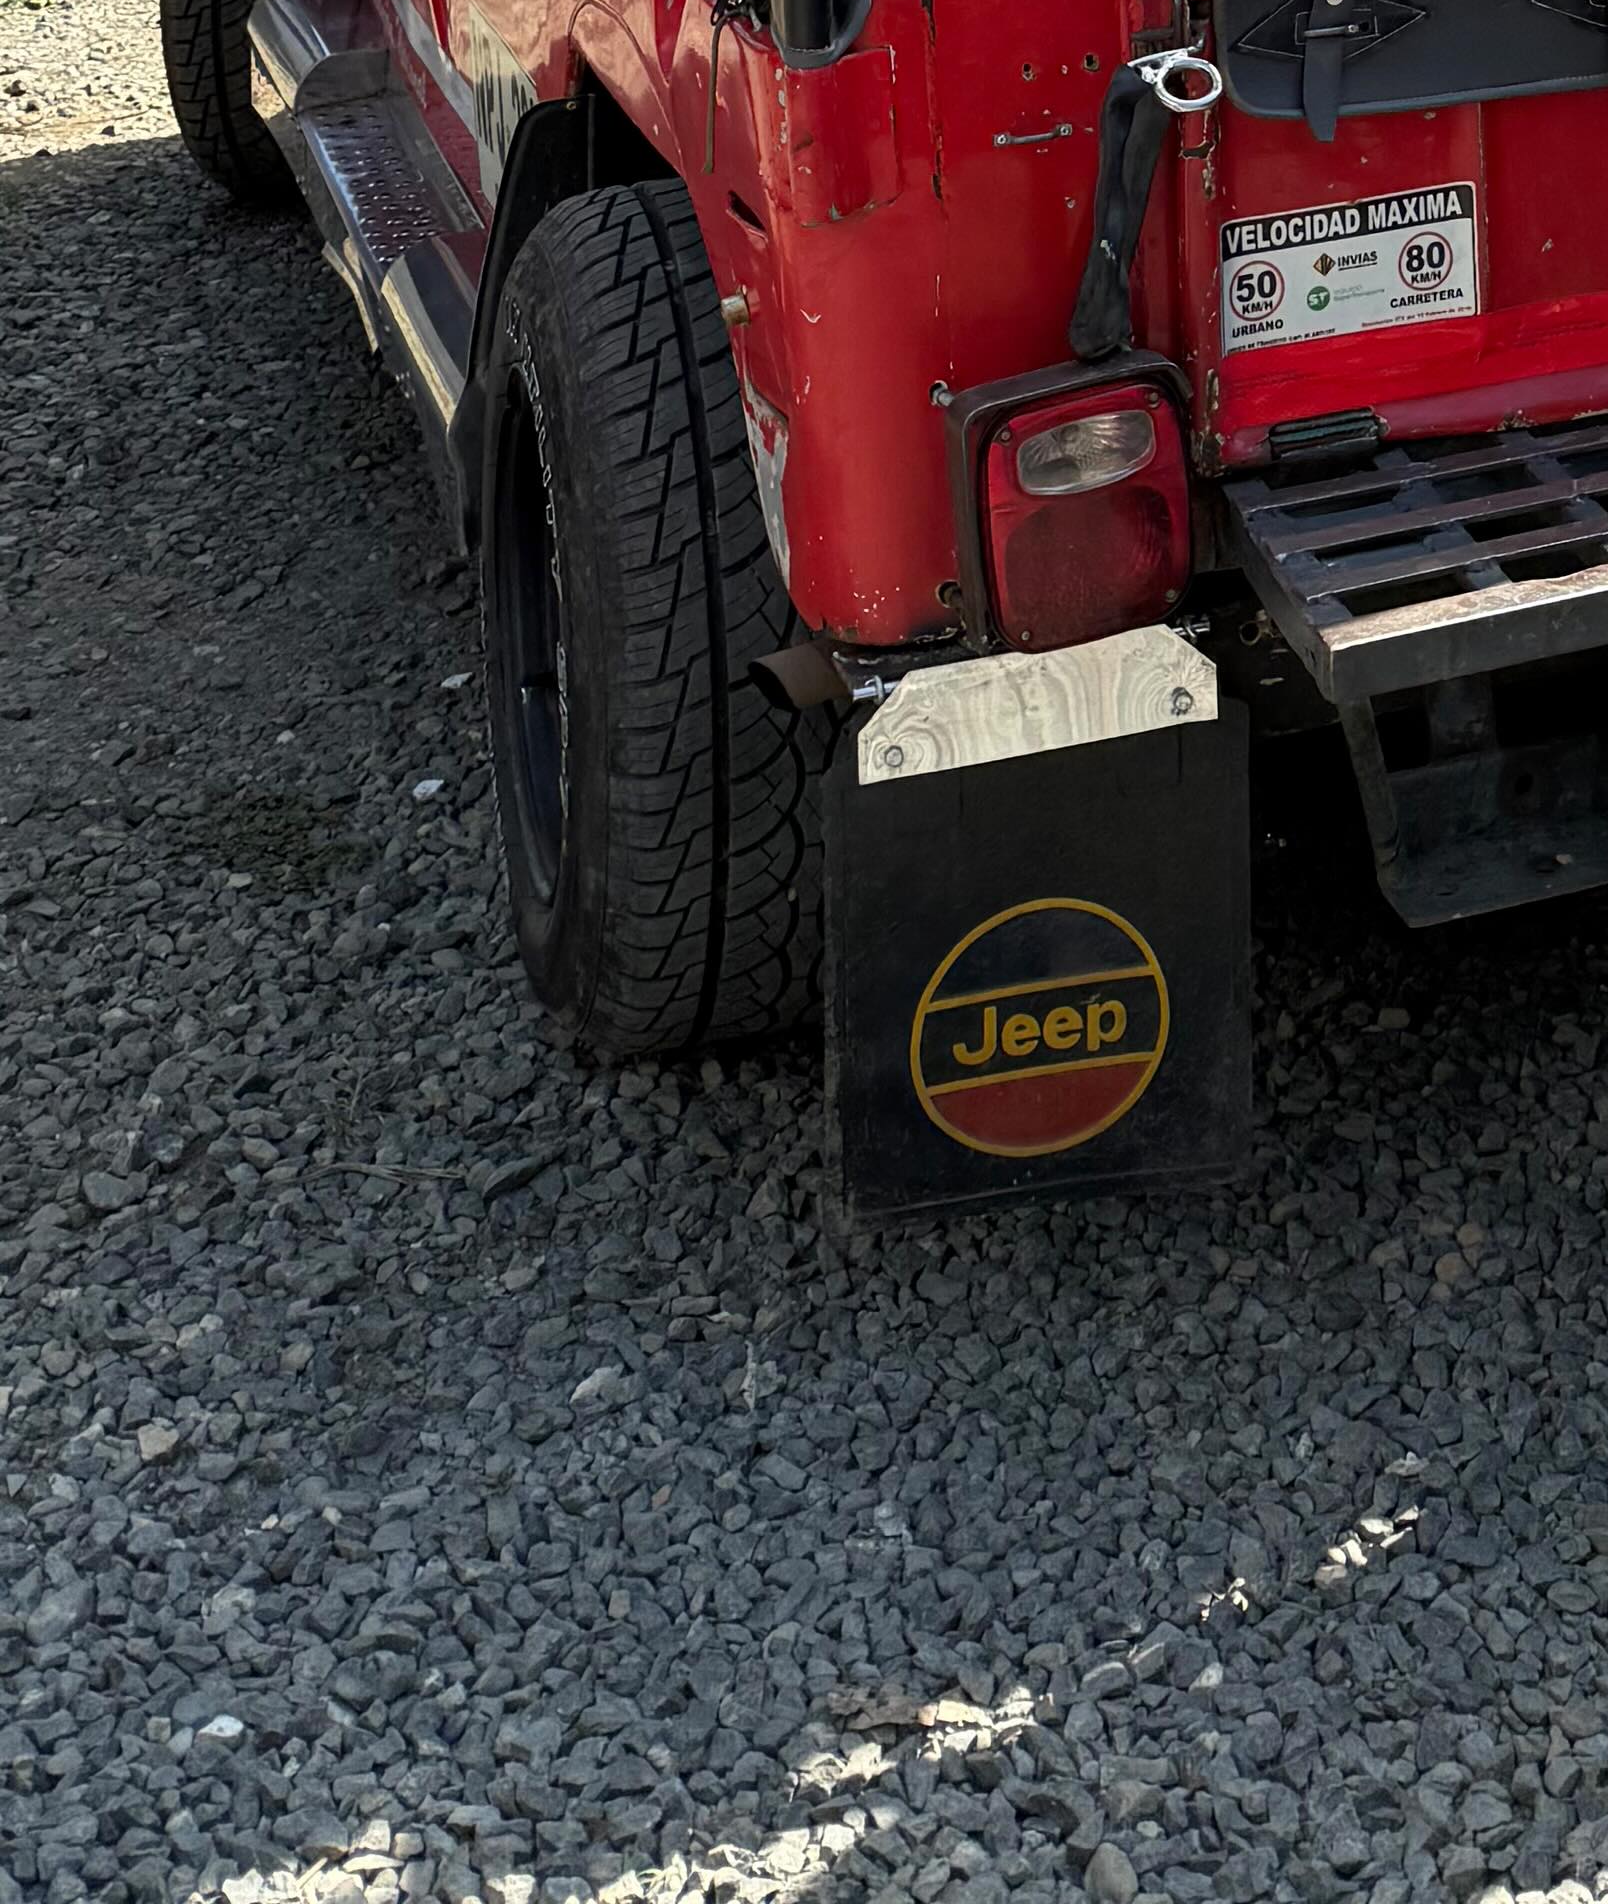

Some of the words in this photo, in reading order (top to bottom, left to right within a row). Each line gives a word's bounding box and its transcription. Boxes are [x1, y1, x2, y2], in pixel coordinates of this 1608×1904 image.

[1226, 208, 1361, 255] VELOCIDAD
[1367, 190, 1463, 231] MAXIMA
[1337, 250, 1378, 268] INVIAS
[1405, 241, 1446, 273] 80
[1236, 270, 1277, 303] 50
[1411, 270, 1442, 284] KM/H
[1242, 300, 1273, 315] KM/H
[1307, 291, 1329, 307] ST
[1390, 288, 1464, 309] CARRETERA
[1232, 318, 1284, 339] URBANO
[952, 998, 1128, 1066] Jeep
